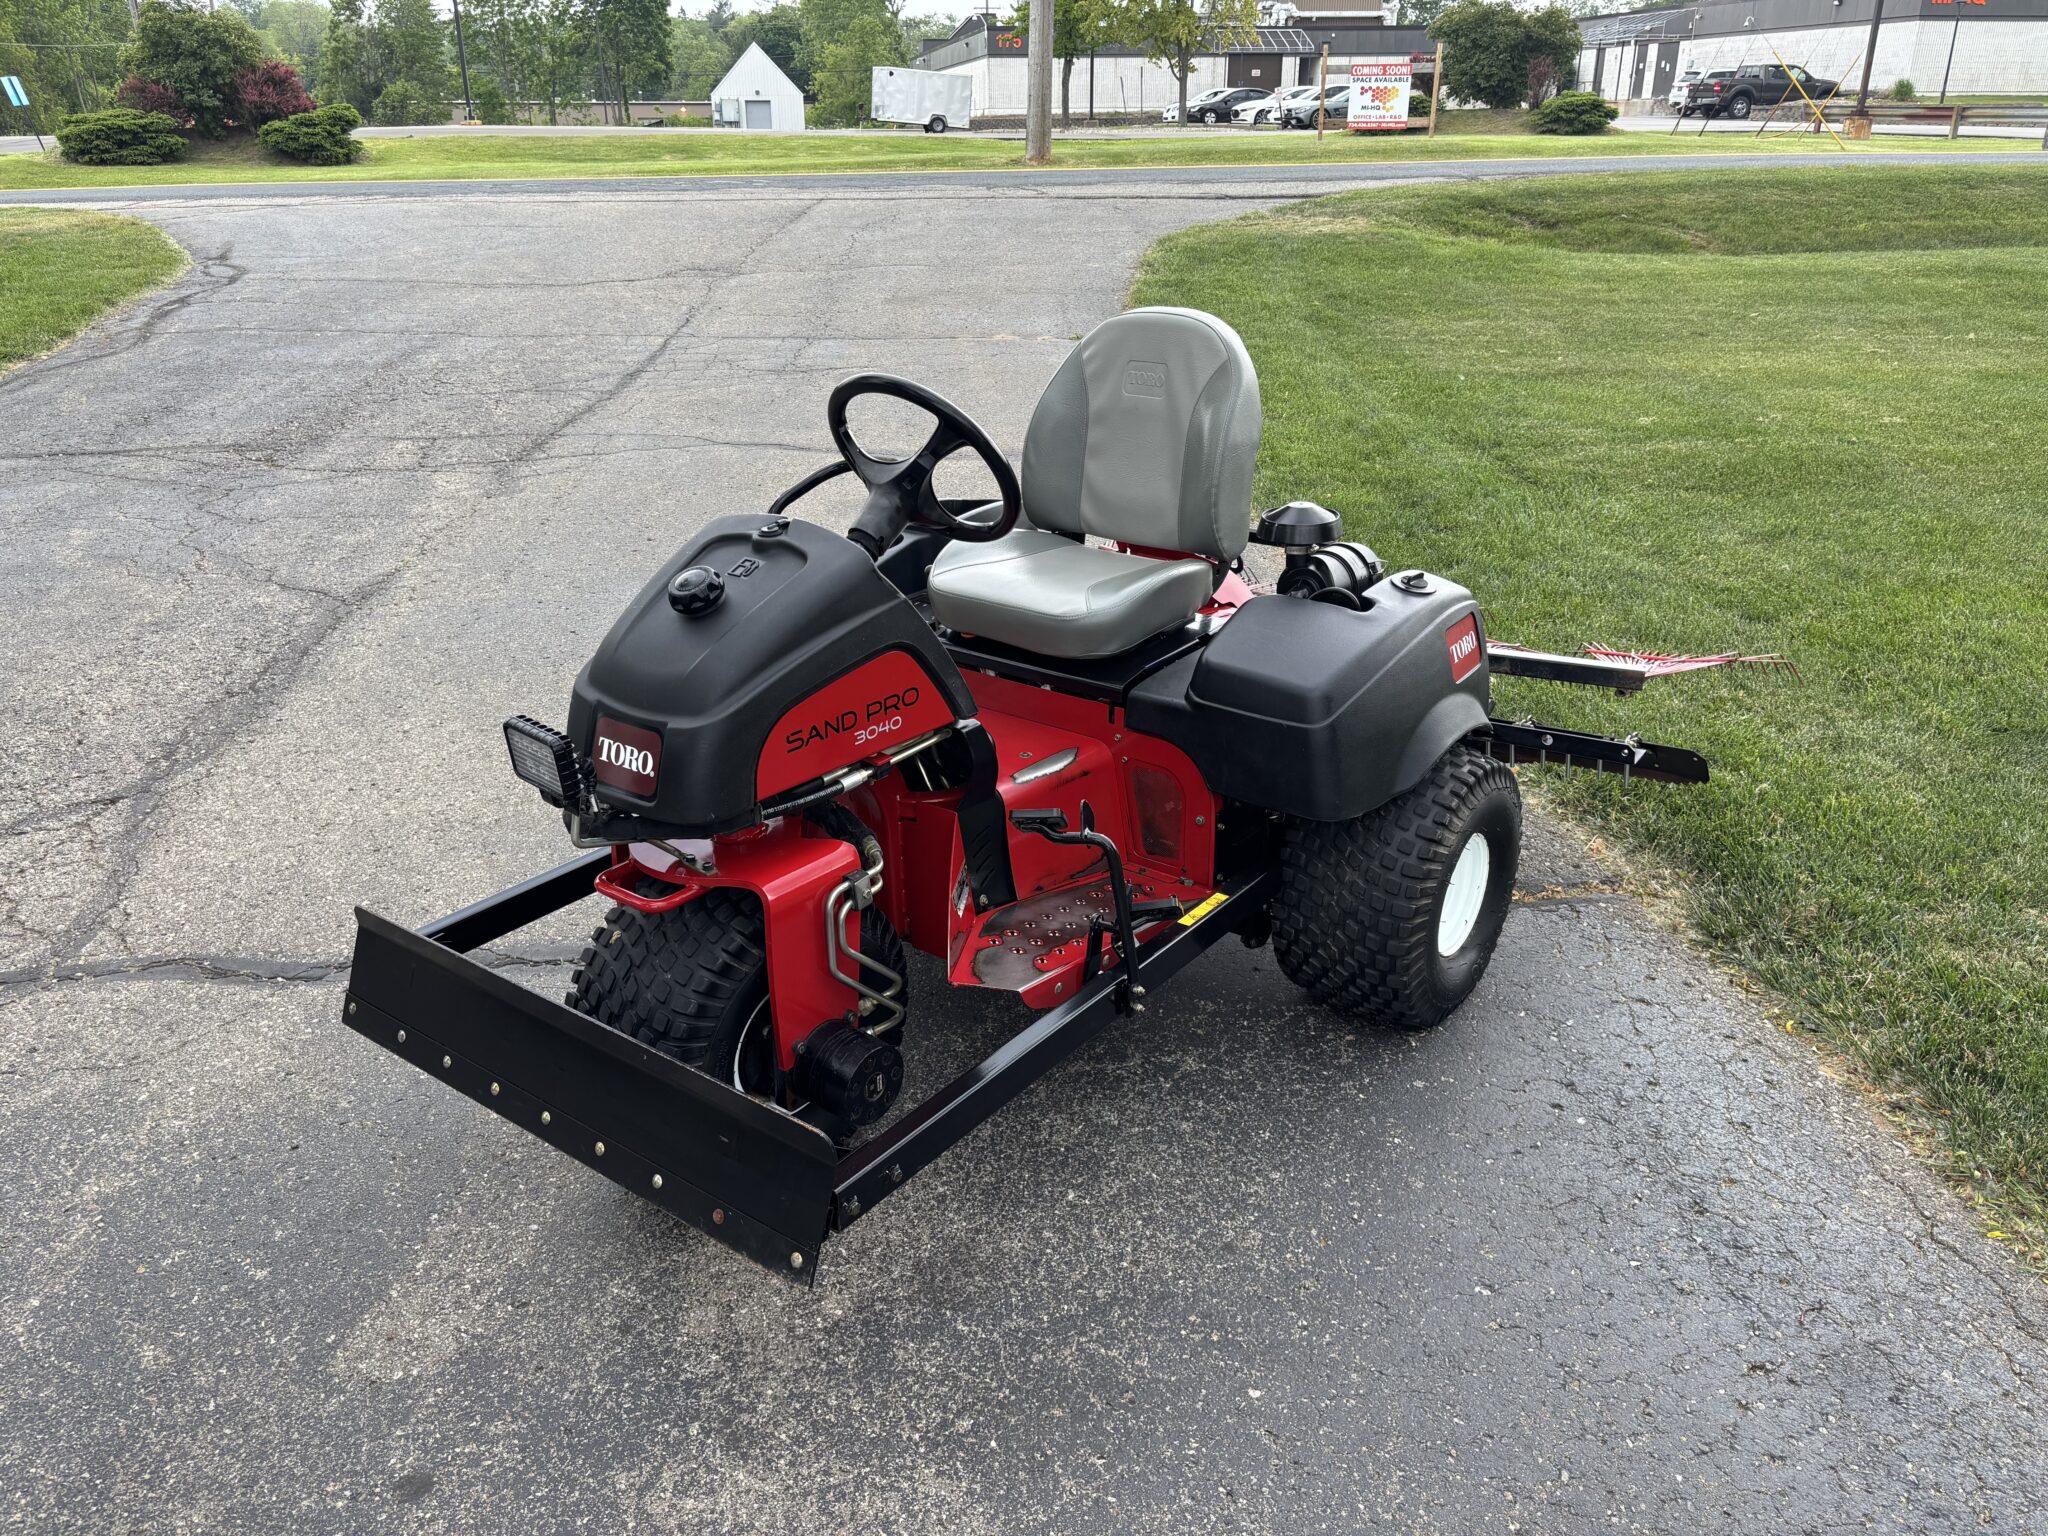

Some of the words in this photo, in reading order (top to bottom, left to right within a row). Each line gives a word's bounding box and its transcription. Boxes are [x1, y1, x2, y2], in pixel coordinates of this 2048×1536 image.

[1352, 66, 1384, 75] COMING
[1385, 66, 1410, 74] SOON!
[1449, 630, 1476, 664] TORO
[786, 711, 858, 753] SAND
[866, 687, 919, 722] PRO
[854, 716, 902, 745] 3040
[598, 736, 654, 775] TORO
